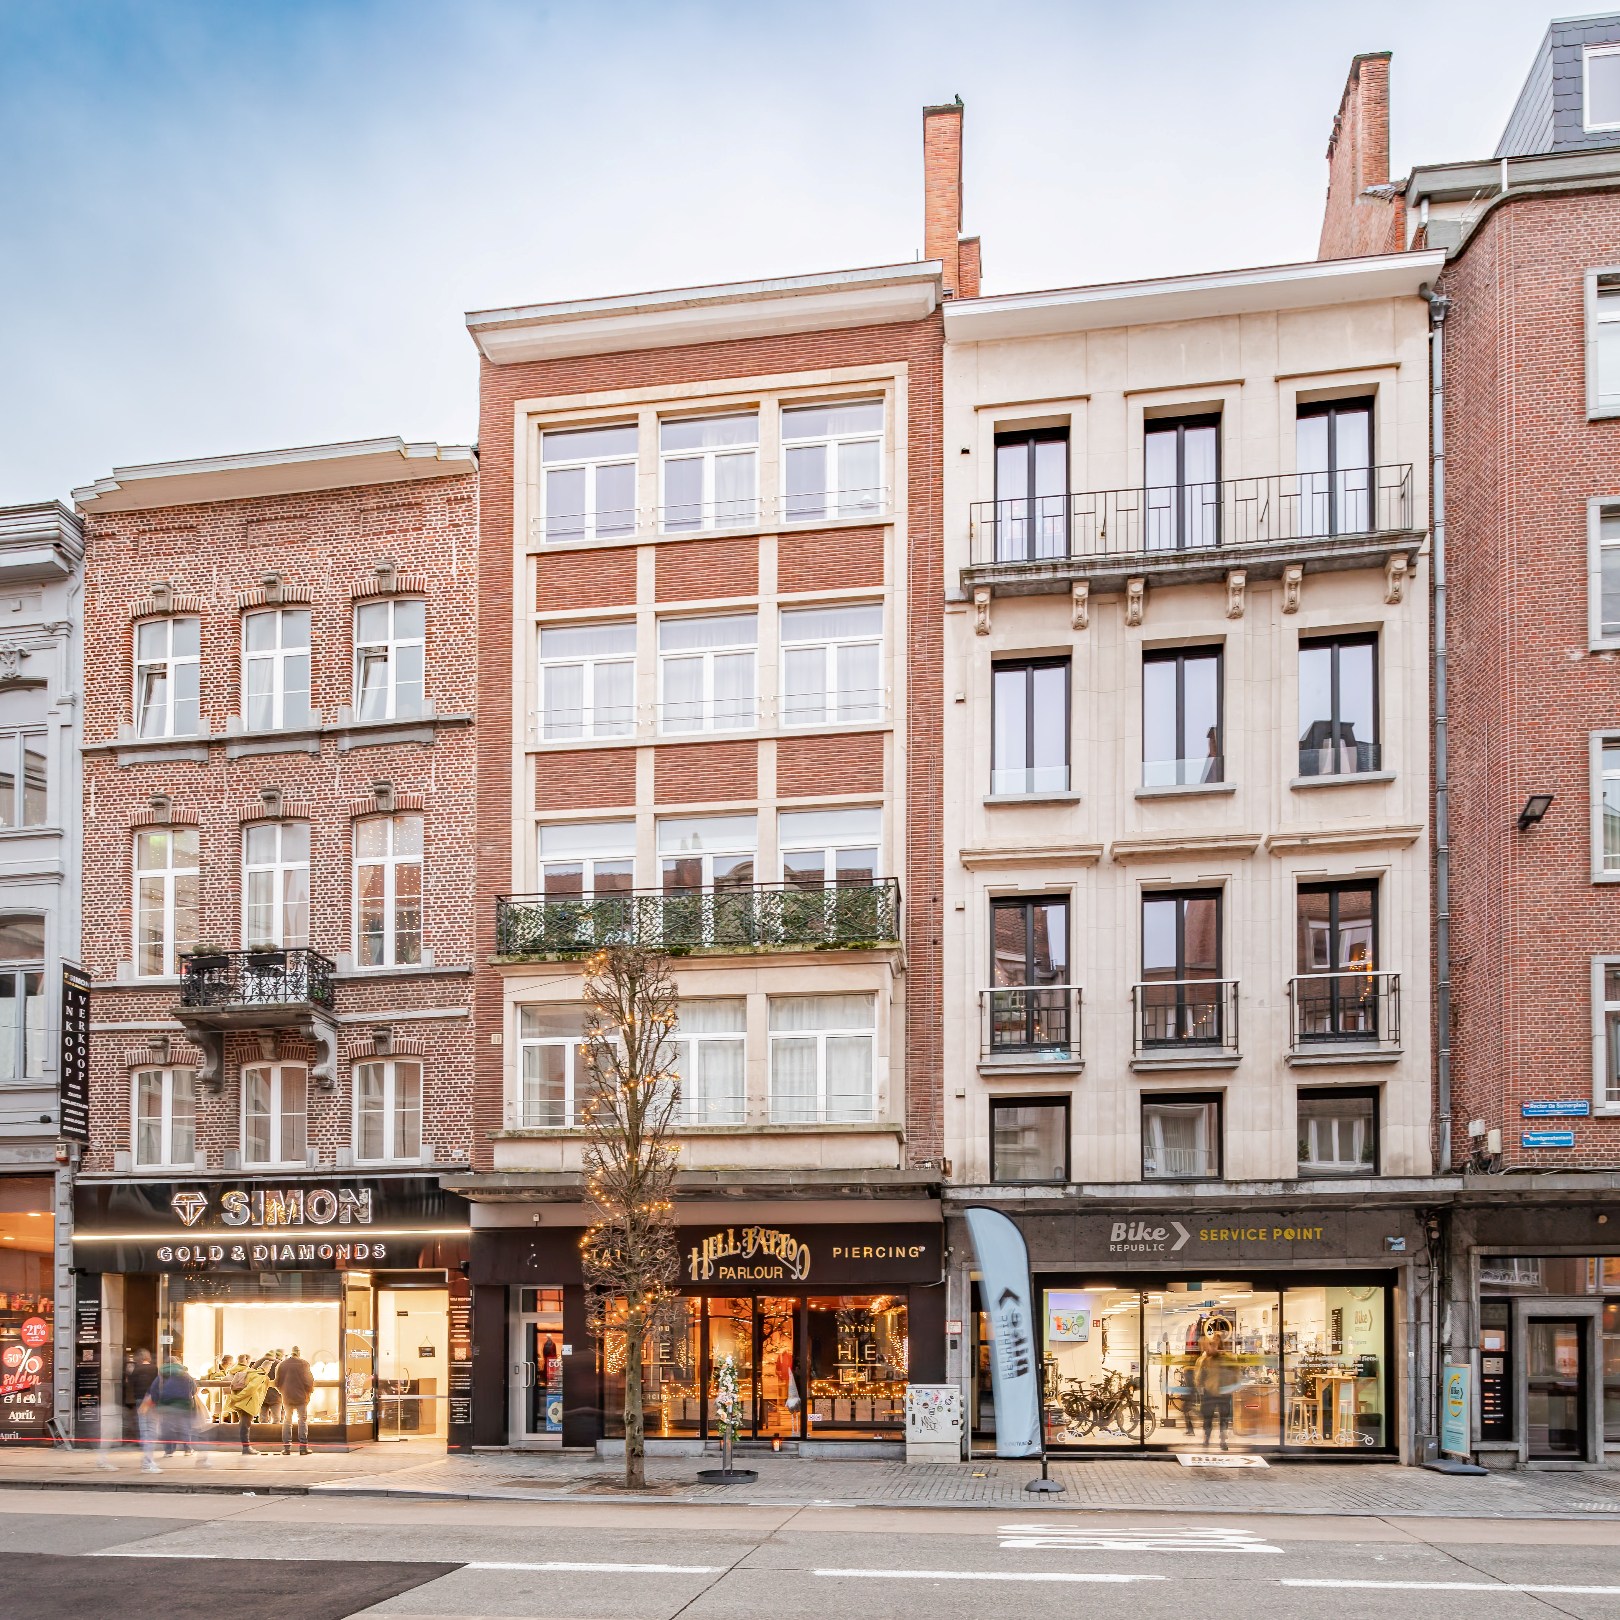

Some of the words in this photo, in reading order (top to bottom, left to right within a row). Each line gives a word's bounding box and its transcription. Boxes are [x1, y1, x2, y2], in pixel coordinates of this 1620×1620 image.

[65, 991, 73, 1077] INKOOP
[77, 995, 86, 1081] VERKOOP
[221, 1188, 372, 1225] SIMON
[1110, 1222, 1170, 1242] Bike
[1199, 1228, 1267, 1241] SERVICE
[1273, 1228, 1323, 1240] POINT
[157, 1245, 223, 1262] GOLD
[231, 1245, 246, 1261] &
[253, 1244, 386, 1261] DIAMONDS
[688, 1228, 742, 1281] HELL
[832, 1246, 920, 1258] PIERCING
[1109, 1244, 1165, 1252] REPUBLIC
[719, 1266, 783, 1279] PARLOUR
[24, 1324, 46, 1336] -21%
